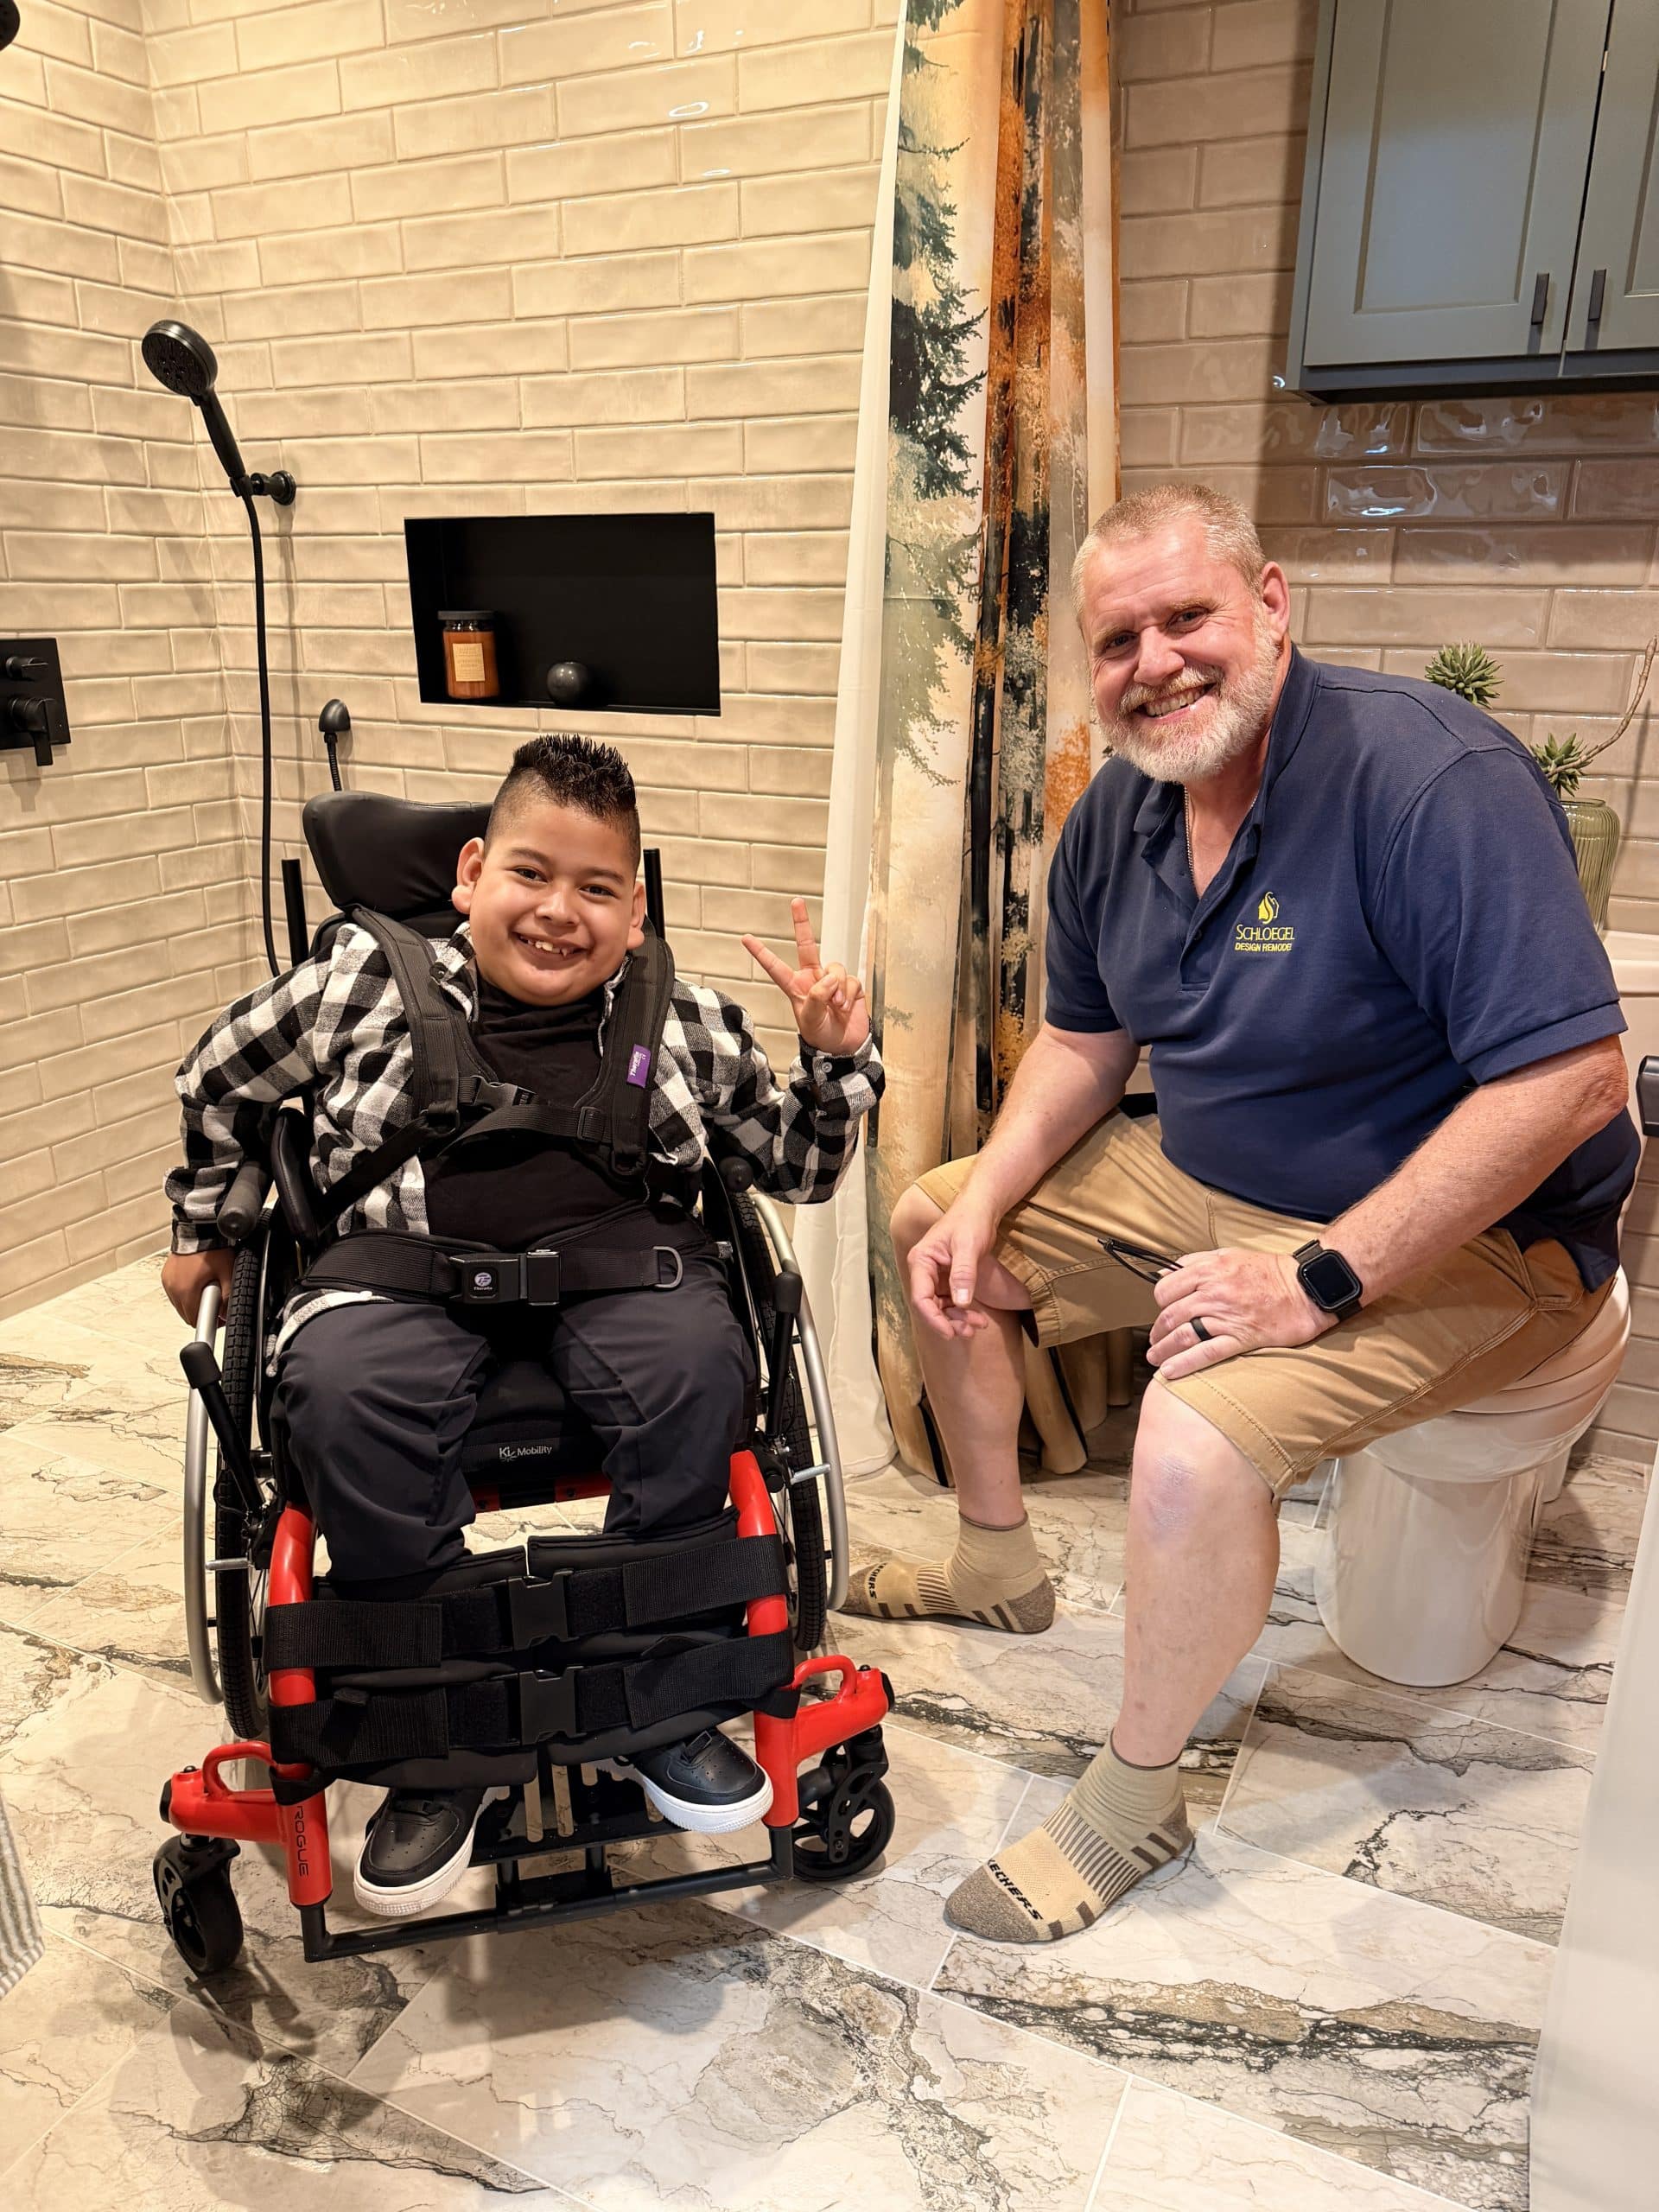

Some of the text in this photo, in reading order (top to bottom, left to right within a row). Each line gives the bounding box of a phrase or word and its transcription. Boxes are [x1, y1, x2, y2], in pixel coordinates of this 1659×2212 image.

[1236, 924, 1295, 941] SCHLOEGEL
[1234, 942, 1262, 952] DESIGN
[517, 1446, 553, 1456] Mobility
[295, 1806, 309, 1877] ROGUE
